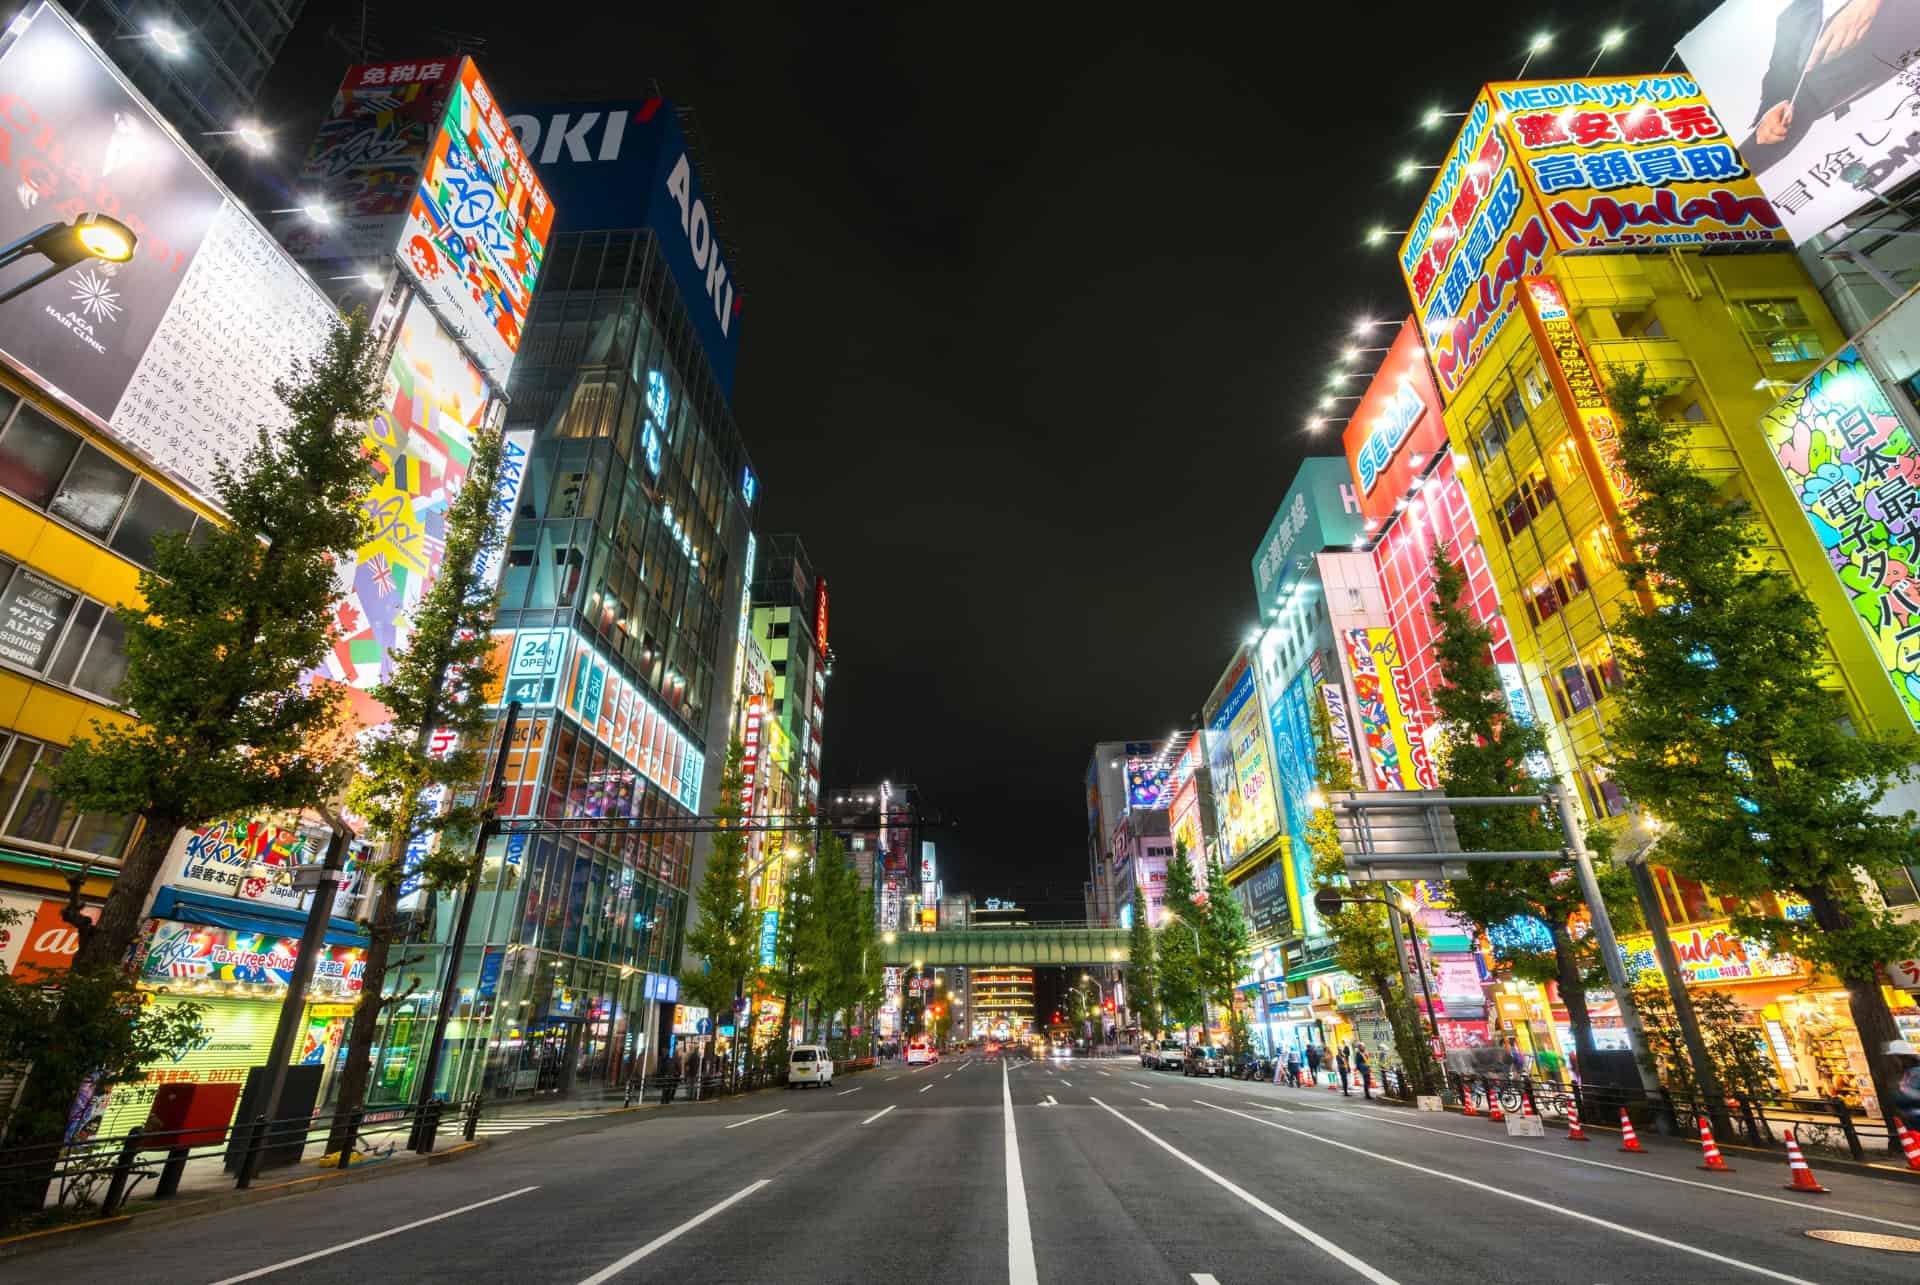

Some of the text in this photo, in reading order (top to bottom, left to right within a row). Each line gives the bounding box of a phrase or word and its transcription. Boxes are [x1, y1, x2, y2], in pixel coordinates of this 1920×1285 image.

[360, 63, 446, 85] 免税店
[1498, 76, 1700, 111] MEDIAリサイクル
[1513, 106, 1722, 147] 激安販売
[1529, 145, 1746, 194] 高額買取
[1549, 190, 1784, 245] Mulan
[667, 152, 735, 339] AOKI
[1654, 232, 1704, 245] AKIBA
[65, 310, 96, 335] AGA
[1547, 321, 1570, 331] DVD
[5, 618, 46, 641] ALPS
[520, 658, 552, 668] OPEN
